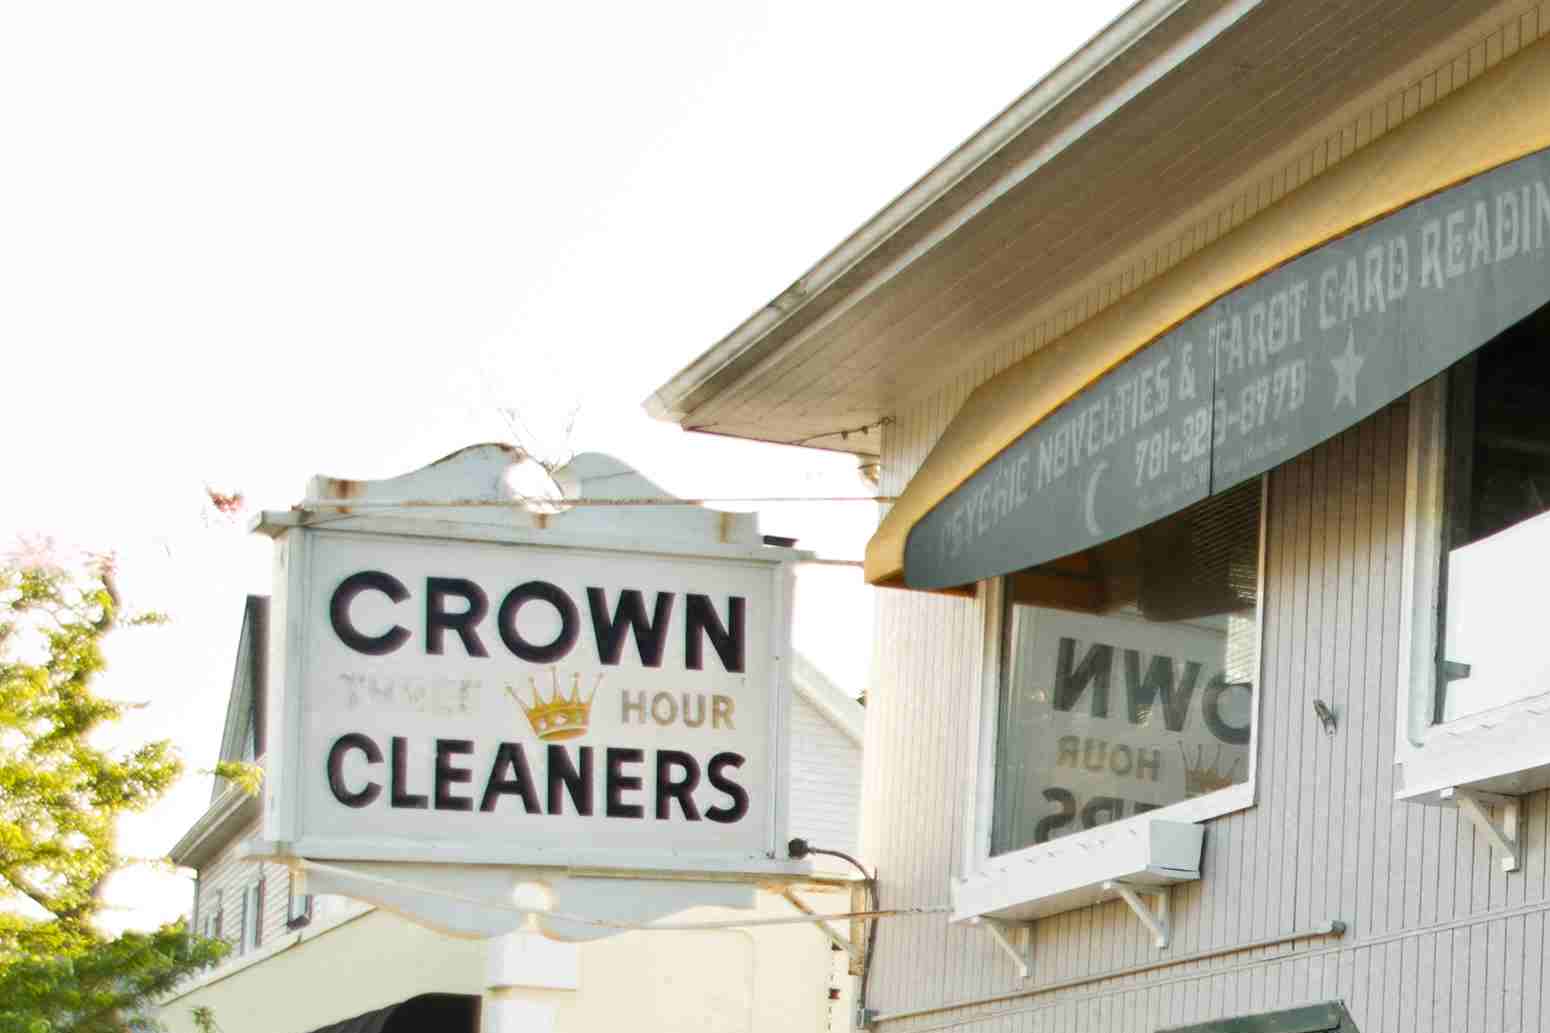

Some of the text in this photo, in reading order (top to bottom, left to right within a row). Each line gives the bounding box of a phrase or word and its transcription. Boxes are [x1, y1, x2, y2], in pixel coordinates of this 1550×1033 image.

[1038, 356, 1171, 491] NOVELTIES
[1179, 342, 1197, 401] &
[1208, 279, 1309, 381] TAROT
[1319, 234, 1408, 329] CARD
[330, 570, 746, 674] CROWN
[621, 690, 736, 730] HOUR
[327, 732, 750, 825] CLEANERS
